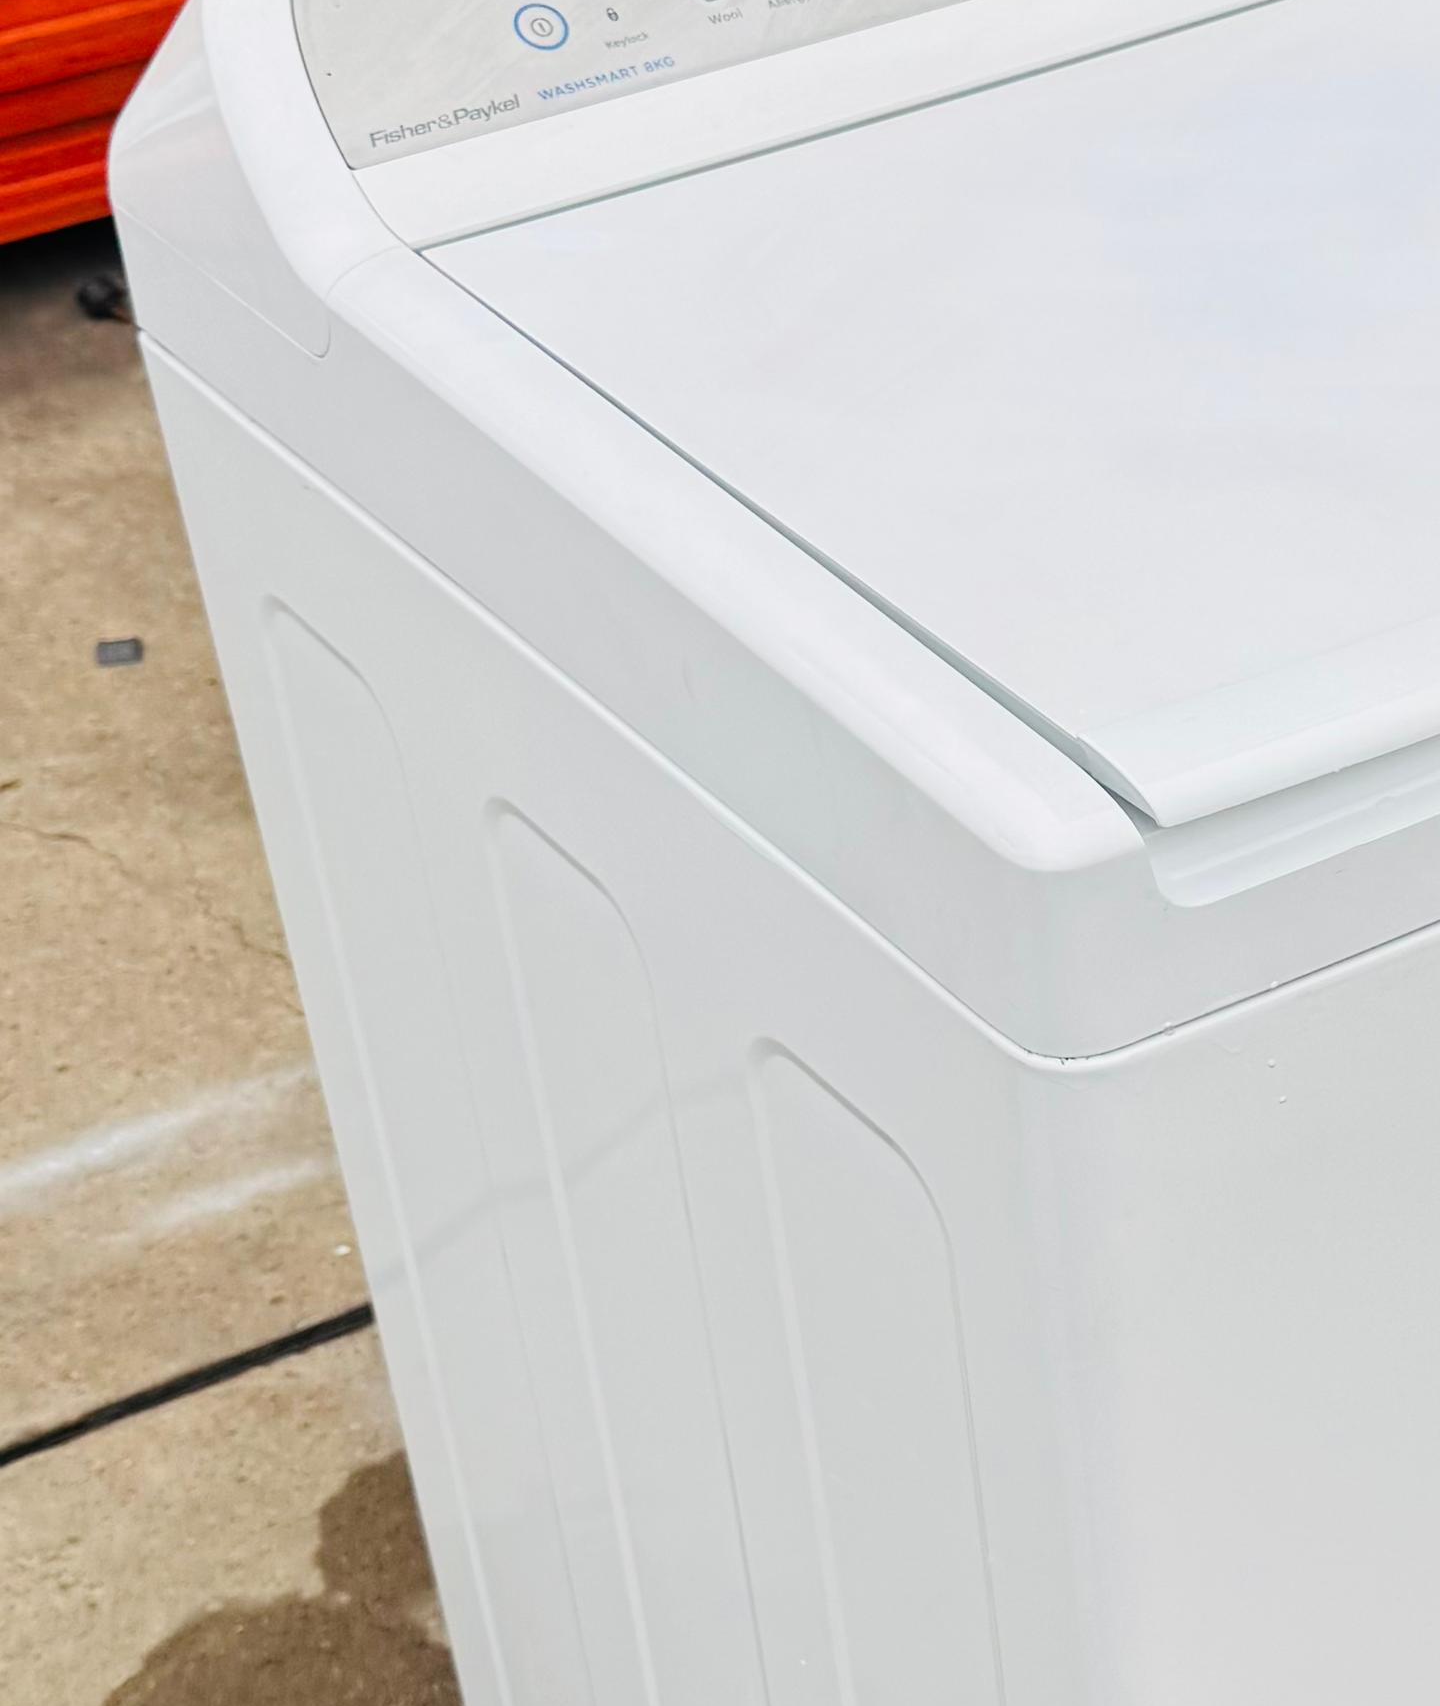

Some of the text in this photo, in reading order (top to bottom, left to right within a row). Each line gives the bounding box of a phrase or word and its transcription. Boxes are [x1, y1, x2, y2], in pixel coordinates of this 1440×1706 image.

[707, 8, 744, 26] Wool
[605, 31, 649, 50] Keylock
[368, 55, 676, 148] Fisher&Paykel WASHSMART 8KG
